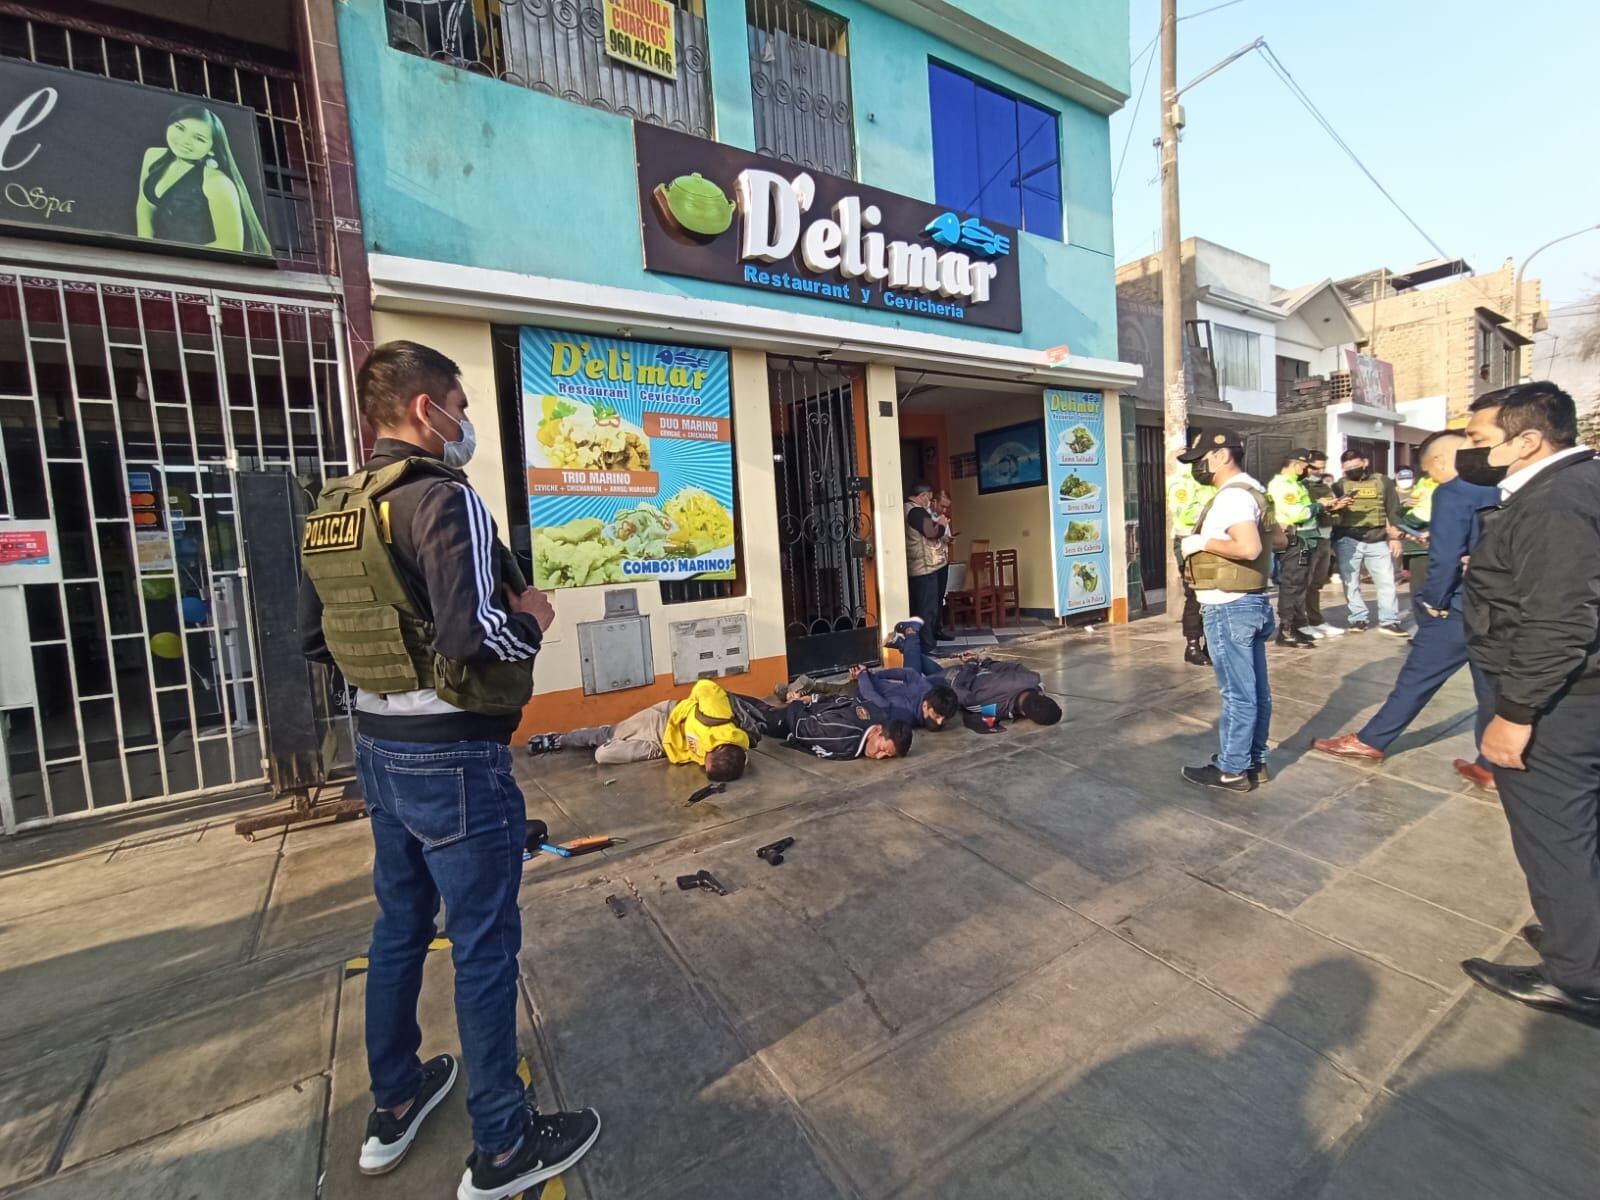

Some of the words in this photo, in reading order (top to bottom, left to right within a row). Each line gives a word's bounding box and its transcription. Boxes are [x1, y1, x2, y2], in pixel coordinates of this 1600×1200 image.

[612, 7, 666, 49] CUARTOS
[609, 28, 632, 58] 960
[634, 39, 653, 66] 421
[654, 48, 673, 74] 476
[5, 182, 75, 219] Spa
[735, 168, 997, 304] D'elimar
[744, 264, 850, 299] Restaurant
[860, 288, 870, 304] y
[883, 291, 965, 319] Cevicheria
[558, 382, 629, 399] Restaurant
[639, 389, 702, 406] Cevicheria
[659, 417, 679, 429] DUO
[682, 419, 718, 432] MARINO
[562, 471, 586, 484] TRIO
[589, 472, 631, 485] MARINO
[303, 515, 354, 548] POLICIA
[623, 560, 675, 575] COMBOS
[678, 559, 731, 573] MARINOS
